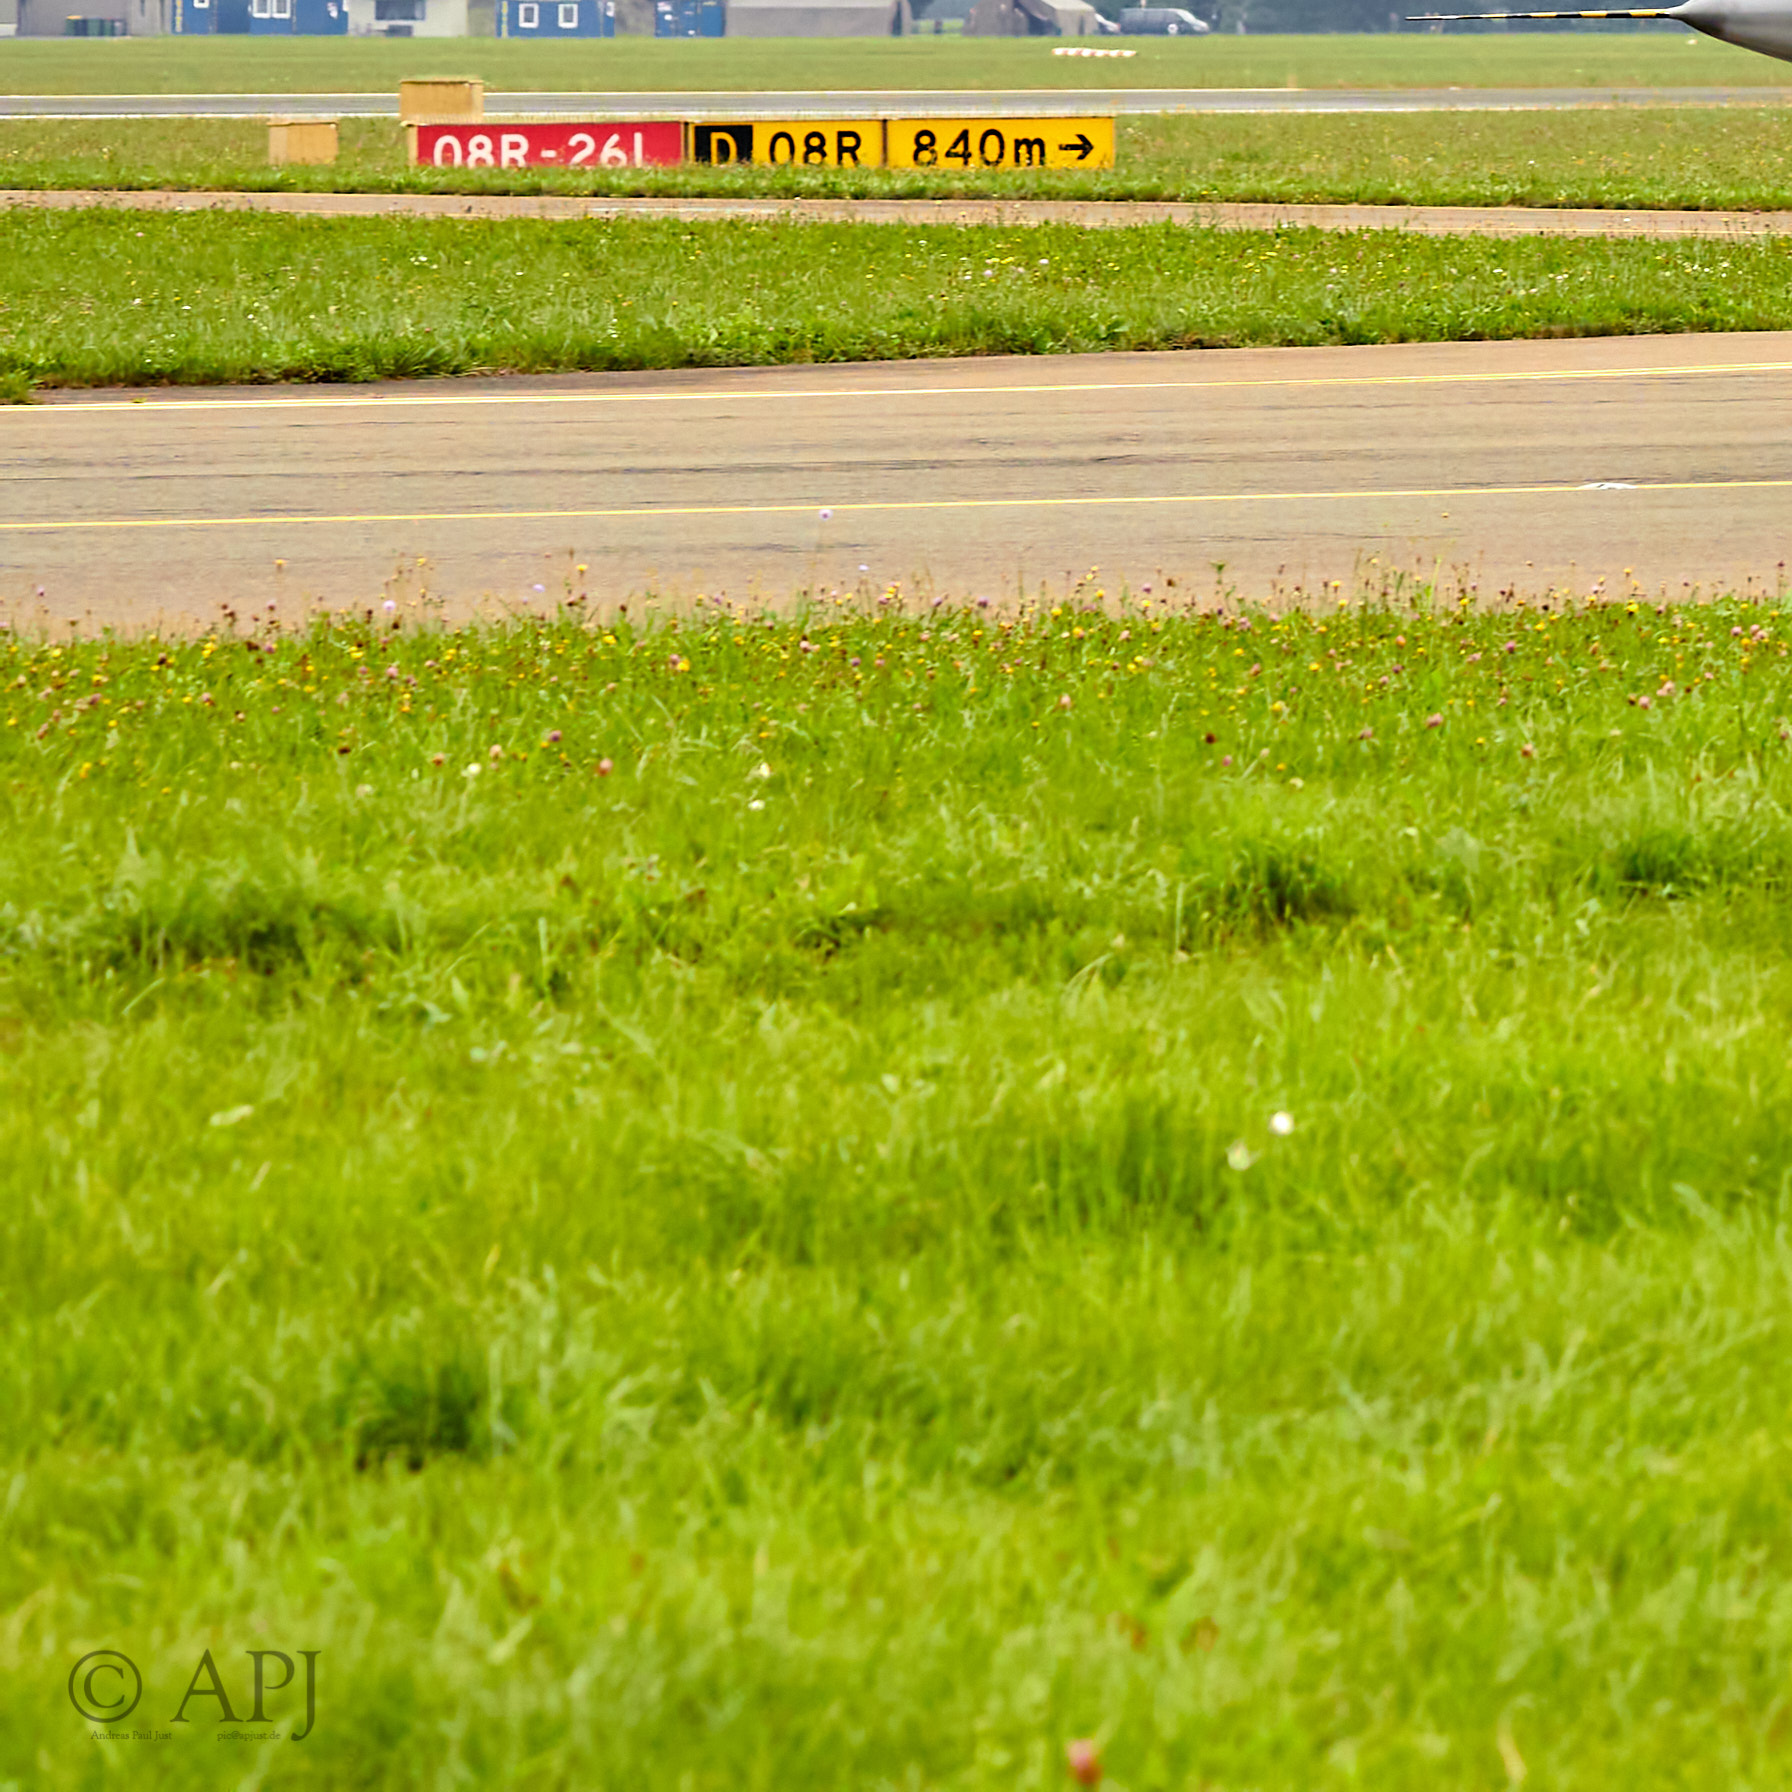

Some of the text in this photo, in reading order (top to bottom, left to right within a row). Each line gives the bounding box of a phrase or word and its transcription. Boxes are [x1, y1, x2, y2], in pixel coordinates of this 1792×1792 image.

[710, 128, 1047, 166] D 08R 840m
